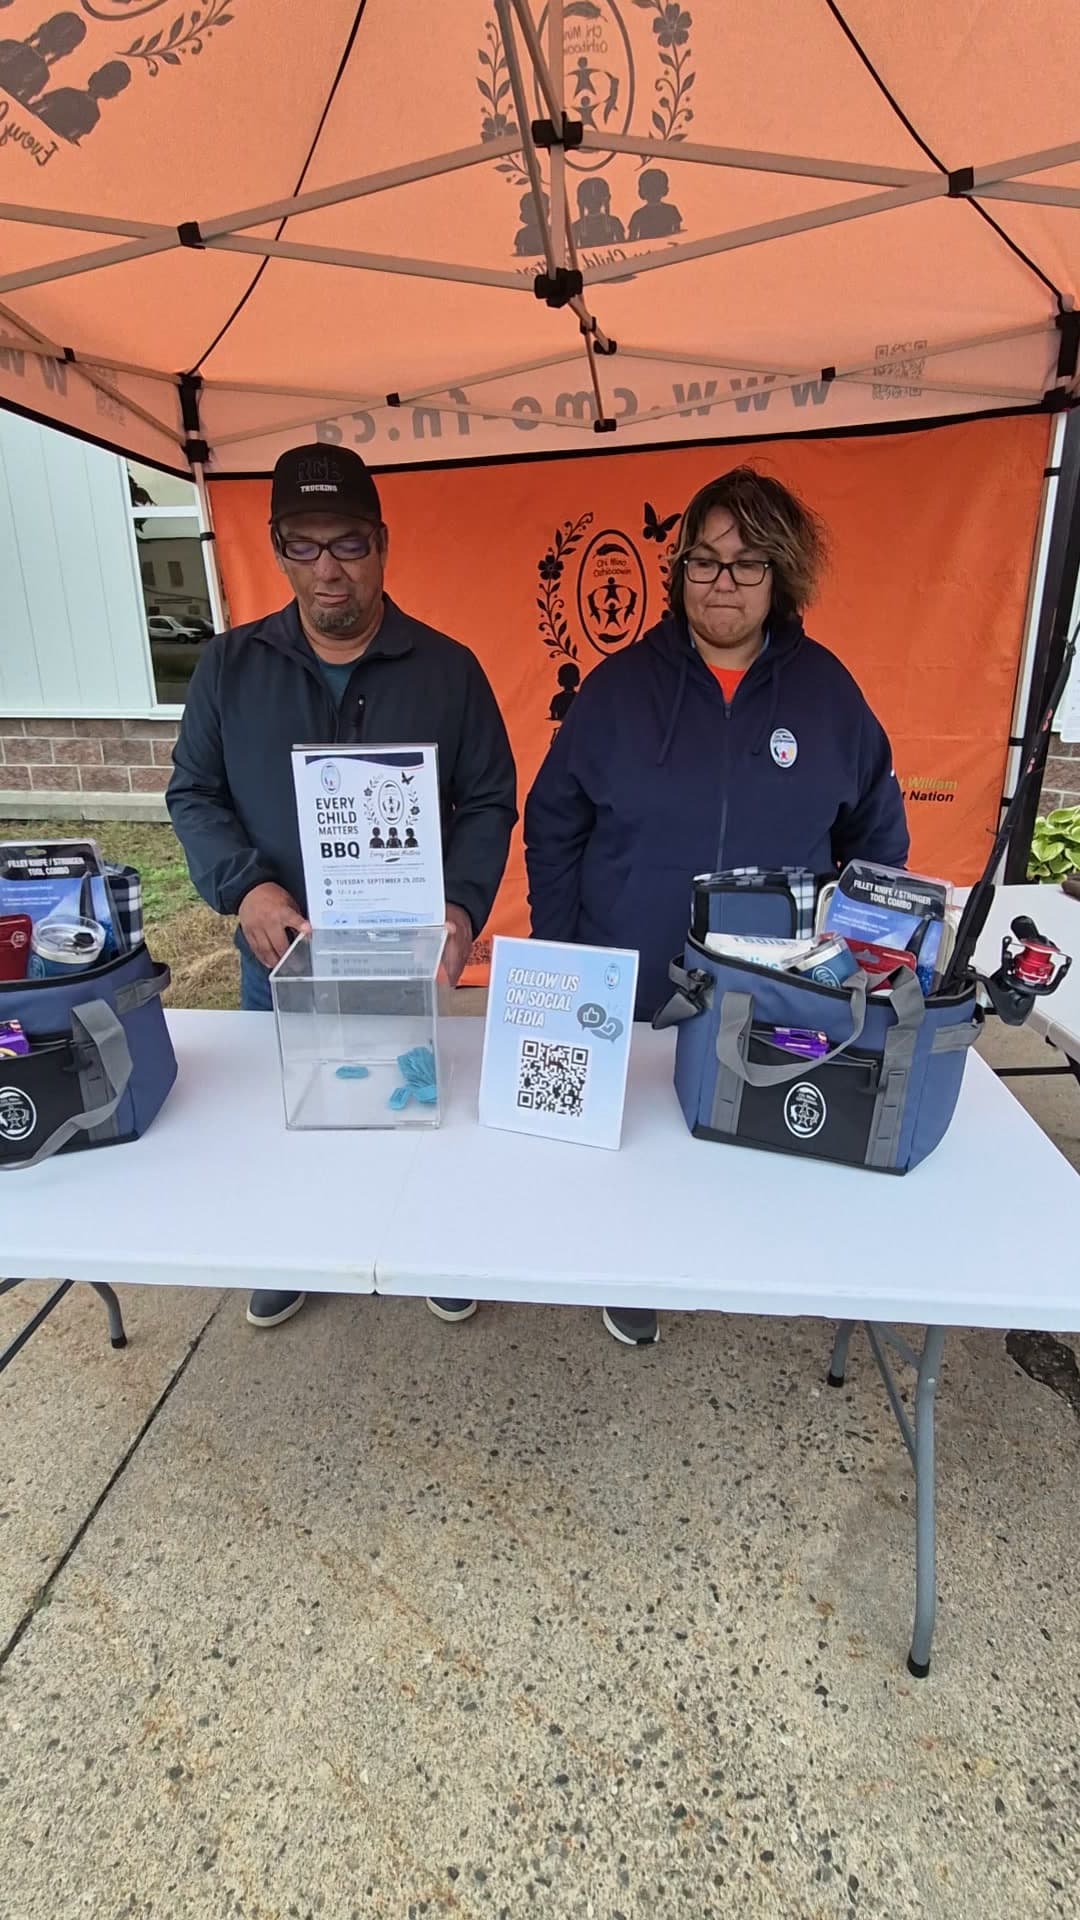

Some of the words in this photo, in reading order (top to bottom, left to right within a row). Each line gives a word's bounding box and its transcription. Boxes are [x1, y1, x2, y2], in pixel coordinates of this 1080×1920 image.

[300, 484, 338, 493] TRUCKING
[907, 777, 958, 790] William
[909, 790, 954, 802] Nation
[316, 797, 355, 810] EVERY
[317, 811, 357, 825] CHILD
[318, 826, 358, 835] MATTERS
[320, 841, 360, 859] BBQ
[7, 859, 28, 868] FILLET
[28, 858, 48, 867] KNIFE
[53, 857, 85, 866] STRINGER
[28, 867, 46, 876] TOOL
[45, 866, 70, 875] COMBO
[367, 877, 401, 885] SEPTEMBER
[853, 879, 875, 893] FILLET
[874, 883, 893, 897] KNIFE
[898, 890, 931, 905] STRINGER
[870, 892, 886, 905] TOOL
[887, 897, 912, 910] COMBO
[507, 968, 560, 989] FOLLOW
[560, 974, 579, 992] US
[506, 987, 527, 1004] ON
[528, 988, 573, 1011] SOCIAL
[503, 1007, 545, 1027] MEDIA
